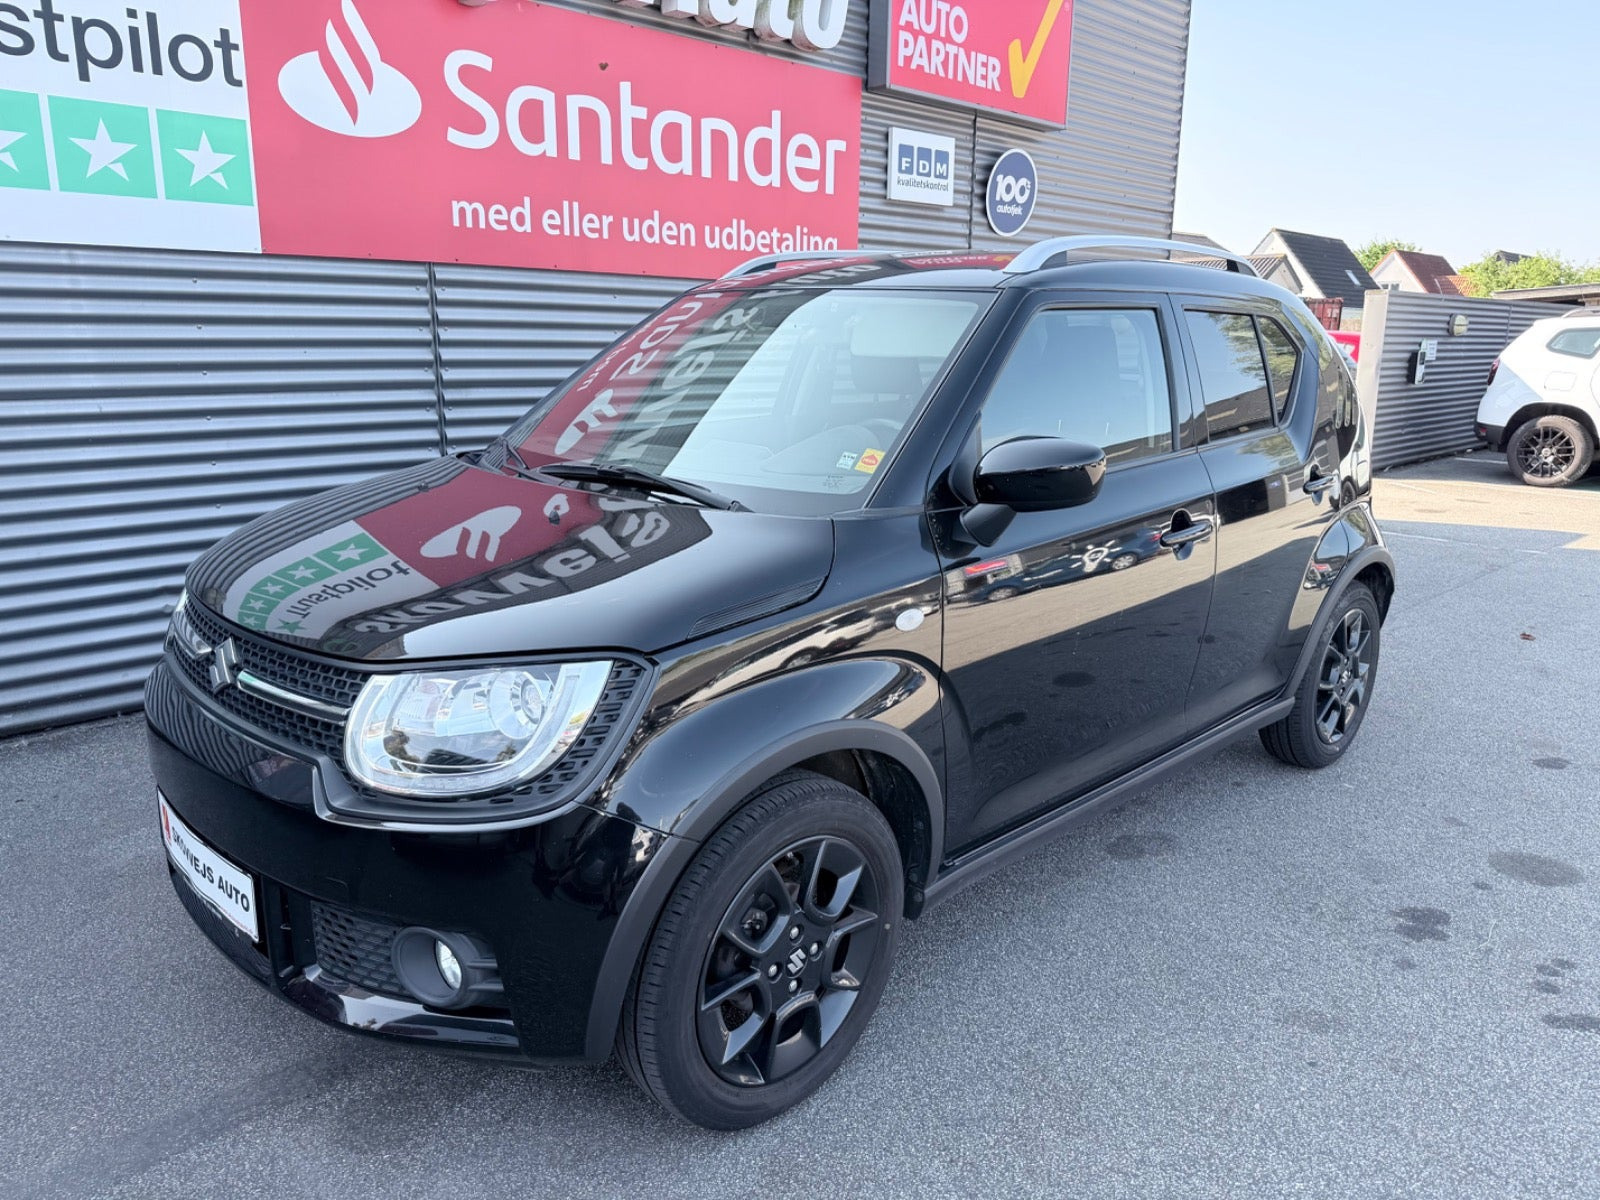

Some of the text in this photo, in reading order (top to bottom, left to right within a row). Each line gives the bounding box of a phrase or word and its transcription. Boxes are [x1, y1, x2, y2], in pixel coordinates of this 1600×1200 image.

[899, 0, 968, 43] AUTO
[898, 30, 1001, 92] PARTNER
[444, 49, 847, 196] Santander
[897, 176, 949, 192] kvalitetskontrol
[901, 157, 947, 176] FDM
[452, 196, 532, 233] med
[542, 200, 614, 240] eller
[622, 210, 696, 247] uden
[218, 875, 250, 912] AUTO
